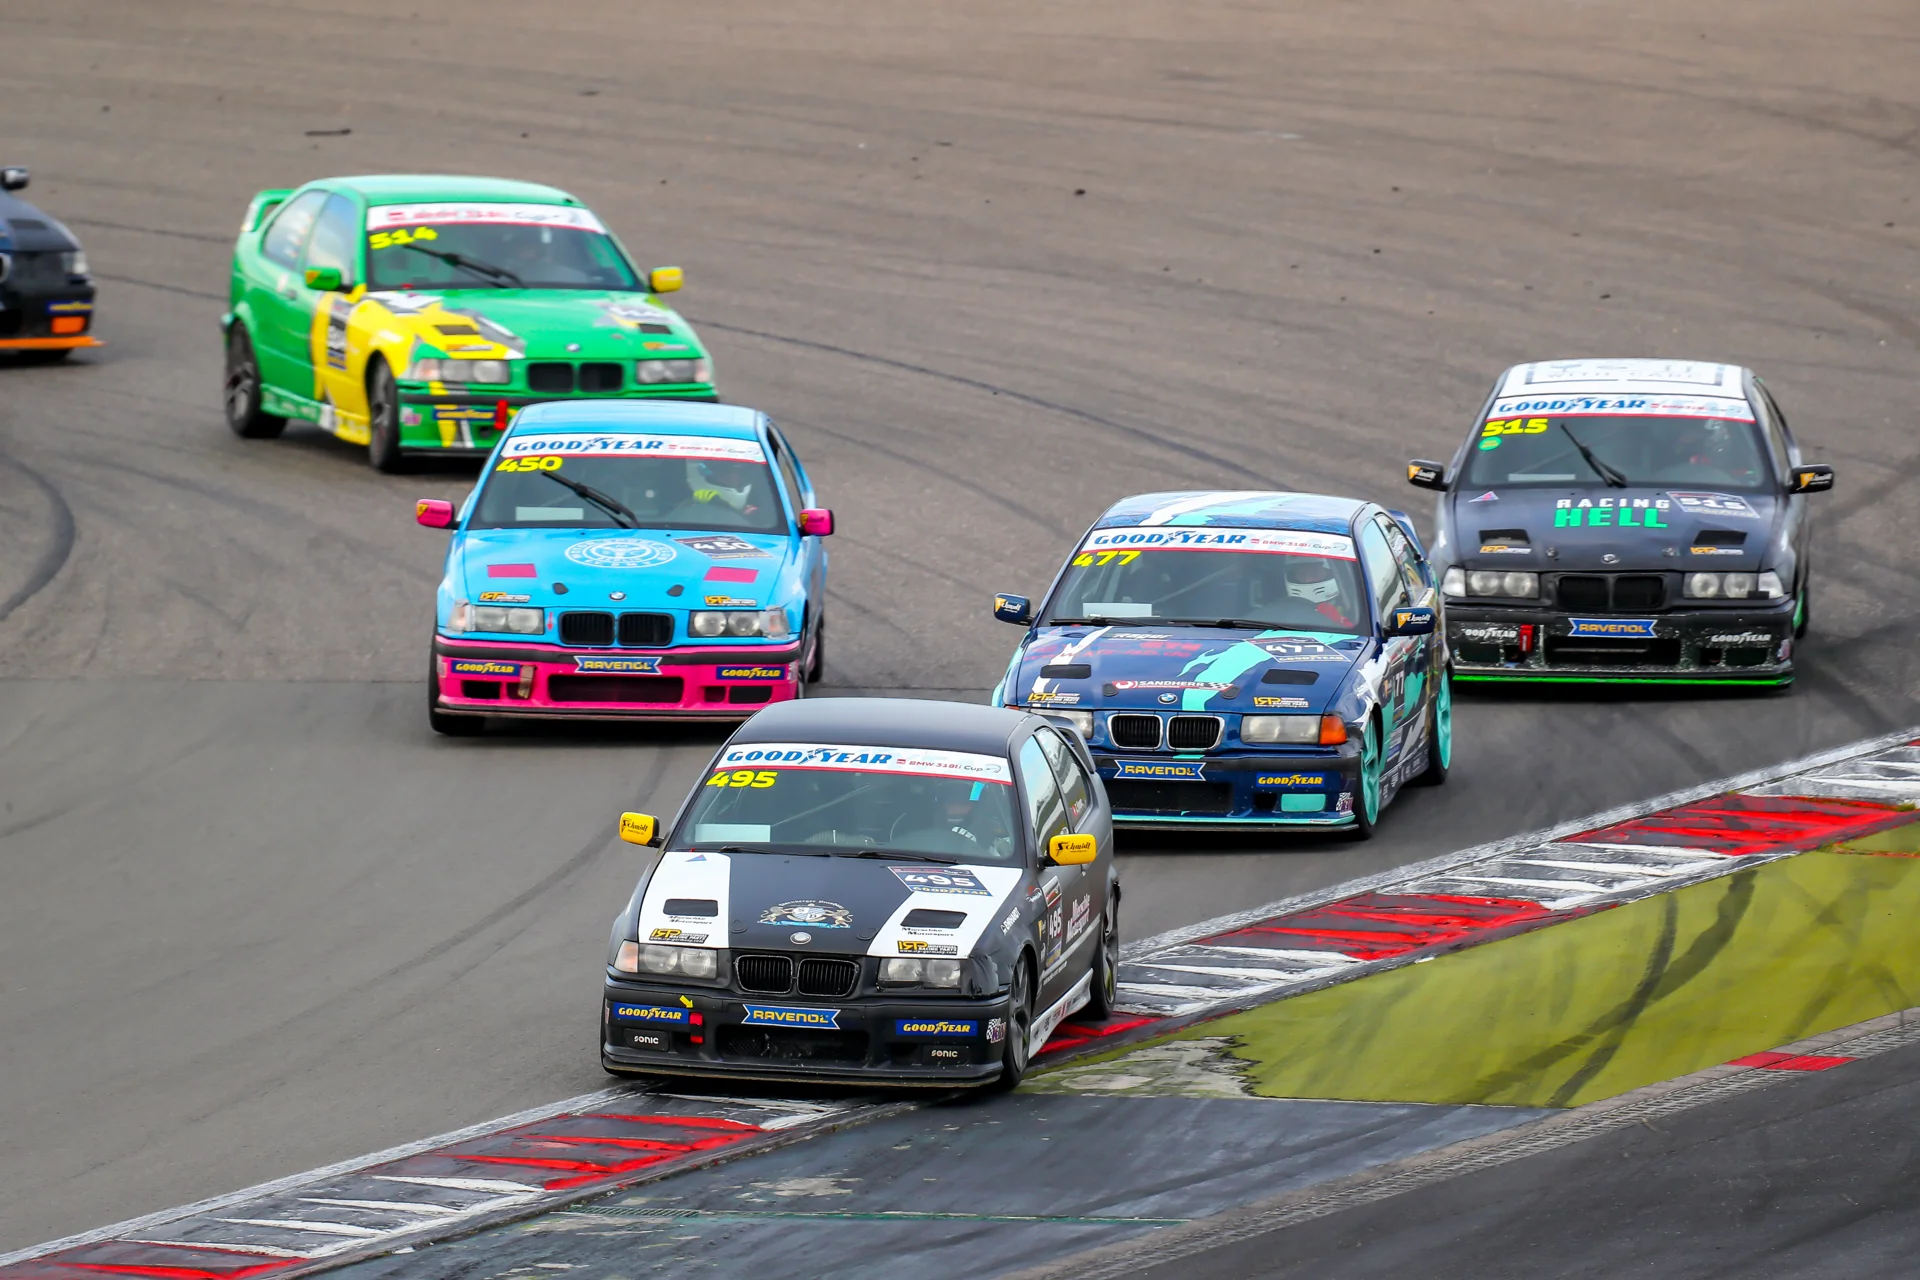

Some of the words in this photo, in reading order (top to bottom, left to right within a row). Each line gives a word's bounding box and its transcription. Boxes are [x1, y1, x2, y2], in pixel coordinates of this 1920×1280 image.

[369, 227, 438, 249] 514
[1500, 397, 1646, 412] GOODYEAR
[1482, 418, 1549, 437] 515
[513, 437, 664, 452] GOODYEAR
[496, 456, 563, 473] 450
[1557, 498, 1671, 508] RACING
[1680, 497, 1746, 510] 515
[1554, 508, 1668, 527] HELL
[1094, 531, 1248, 546] GOODYEAR
[693, 541, 754, 551] 450
[1072, 551, 1142, 567] 477
[1579, 624, 1648, 633] RAVENOL
[1266, 644, 1325, 653] 477
[456, 662, 515, 674] GOODYEAR
[584, 661, 652, 670] RAVENOL
[721, 668, 781, 679] GOODYEAR
[726, 748, 892, 765] GOODYEAR
[1125, 763, 1195, 776] RAVENOL
[706, 770, 778, 788] 495
[1258, 774, 1323, 786] GOODYEAR
[1057, 841, 1091, 852] Schmidt
[904, 874, 976, 887] 495
[912, 886, 988, 896] GOODYEAR
[1049, 906, 1062, 938] 495
[618, 1007, 682, 1020] GOODYEAR
[753, 1009, 829, 1024] RAVENOL
[903, 1022, 971, 1034] GOODYEAR
